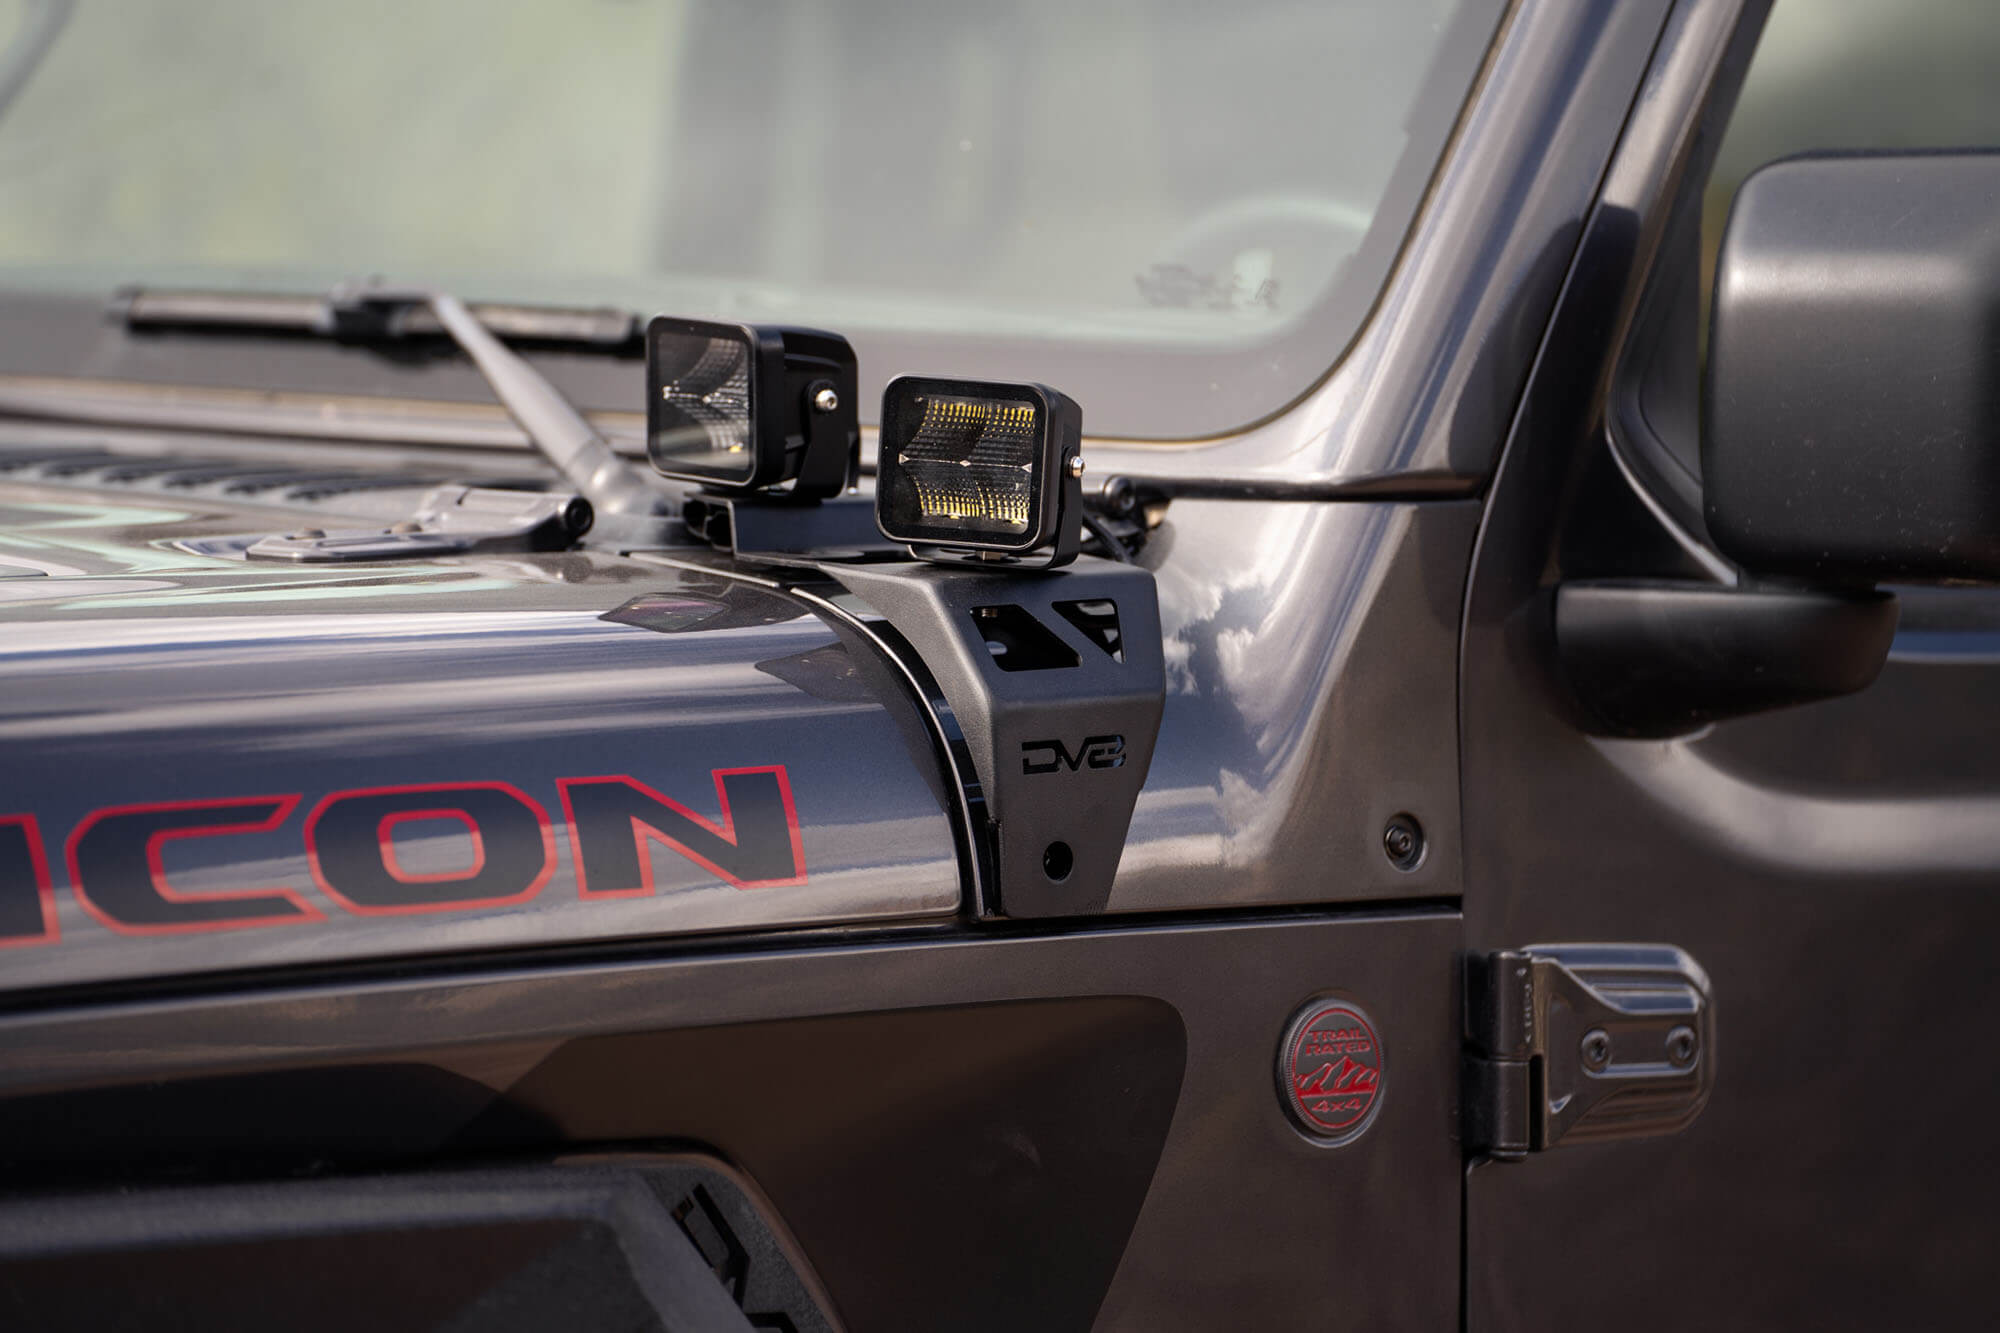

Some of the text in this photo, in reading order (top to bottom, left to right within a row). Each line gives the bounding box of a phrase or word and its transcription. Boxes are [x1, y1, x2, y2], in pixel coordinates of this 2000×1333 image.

[1309, 1028, 1367, 1042] TRAIL
[1305, 1040, 1371, 1055] RATED
[1311, 1097, 1361, 1112] 4x4
